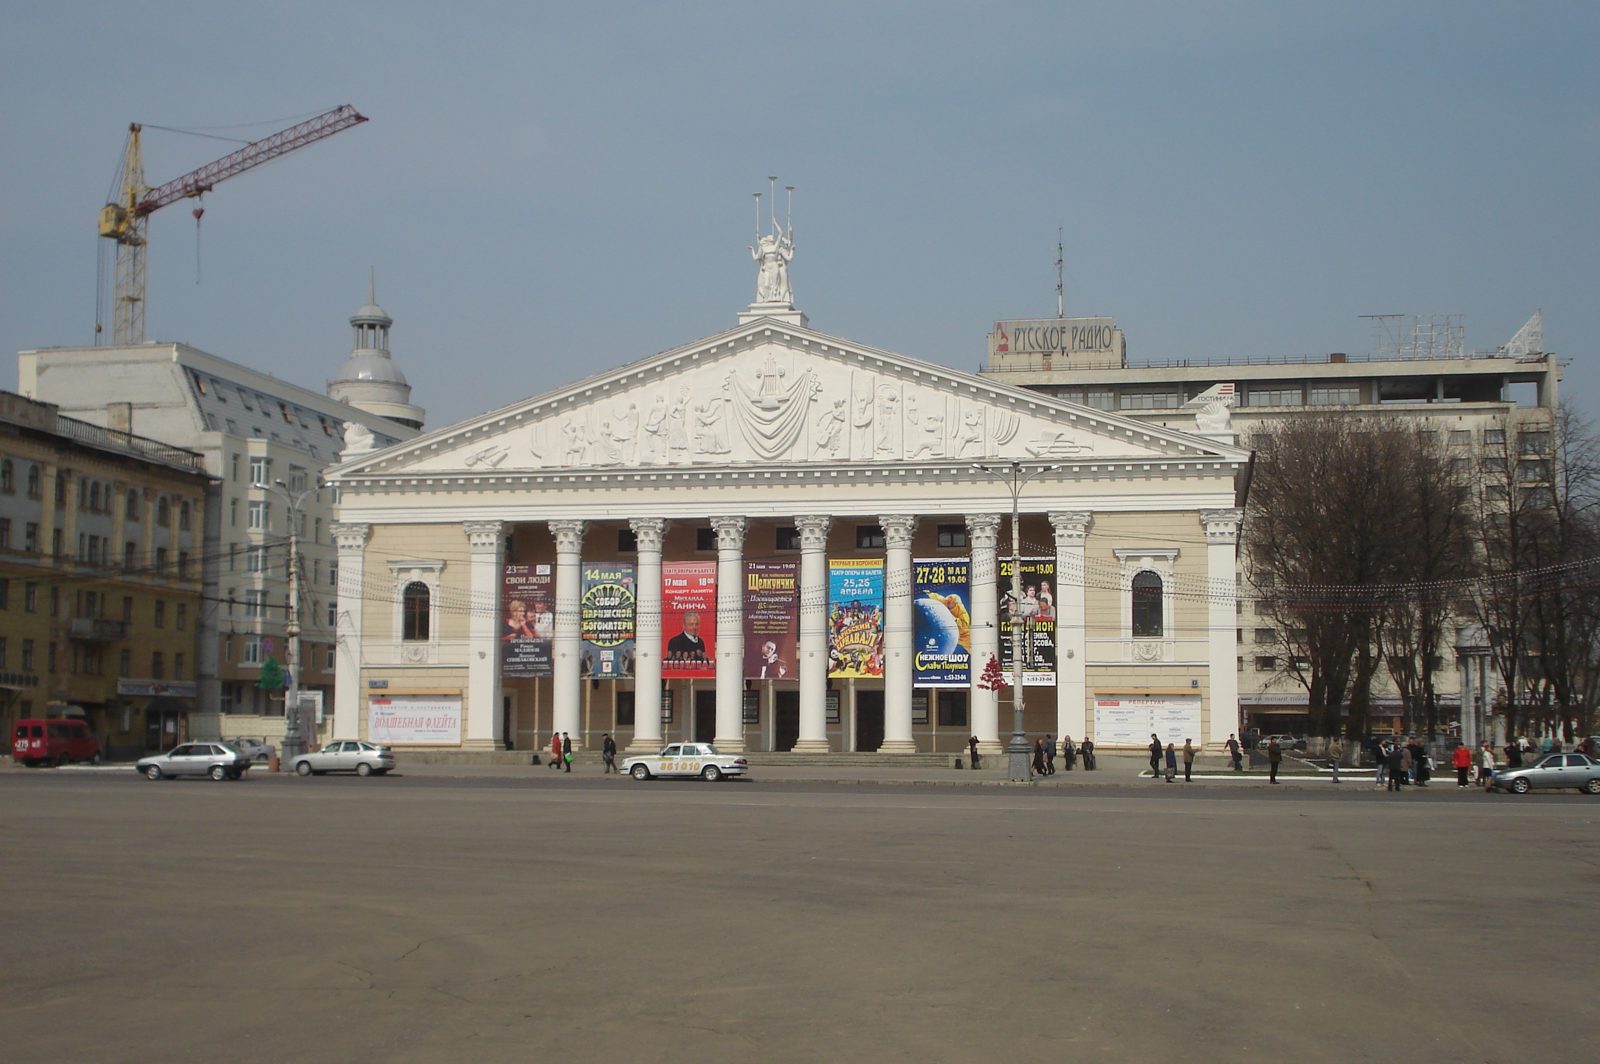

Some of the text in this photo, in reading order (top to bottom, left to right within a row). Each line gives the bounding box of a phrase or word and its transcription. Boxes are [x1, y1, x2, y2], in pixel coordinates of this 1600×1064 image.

[1014, 324, 1112, 351] РУССКОЕ РАДИО
[1036, 564, 1054, 574] 19.00
[584, 569, 622, 580] 14 МАЯ
[917, 566, 967, 584] 27-28 МАЯ
[665, 578, 672, 586] 17
[748, 574, 795, 591] Щелкунчик
[594, 597, 621, 606] СОБОР
[948, 654, 969, 662] ШОУ
